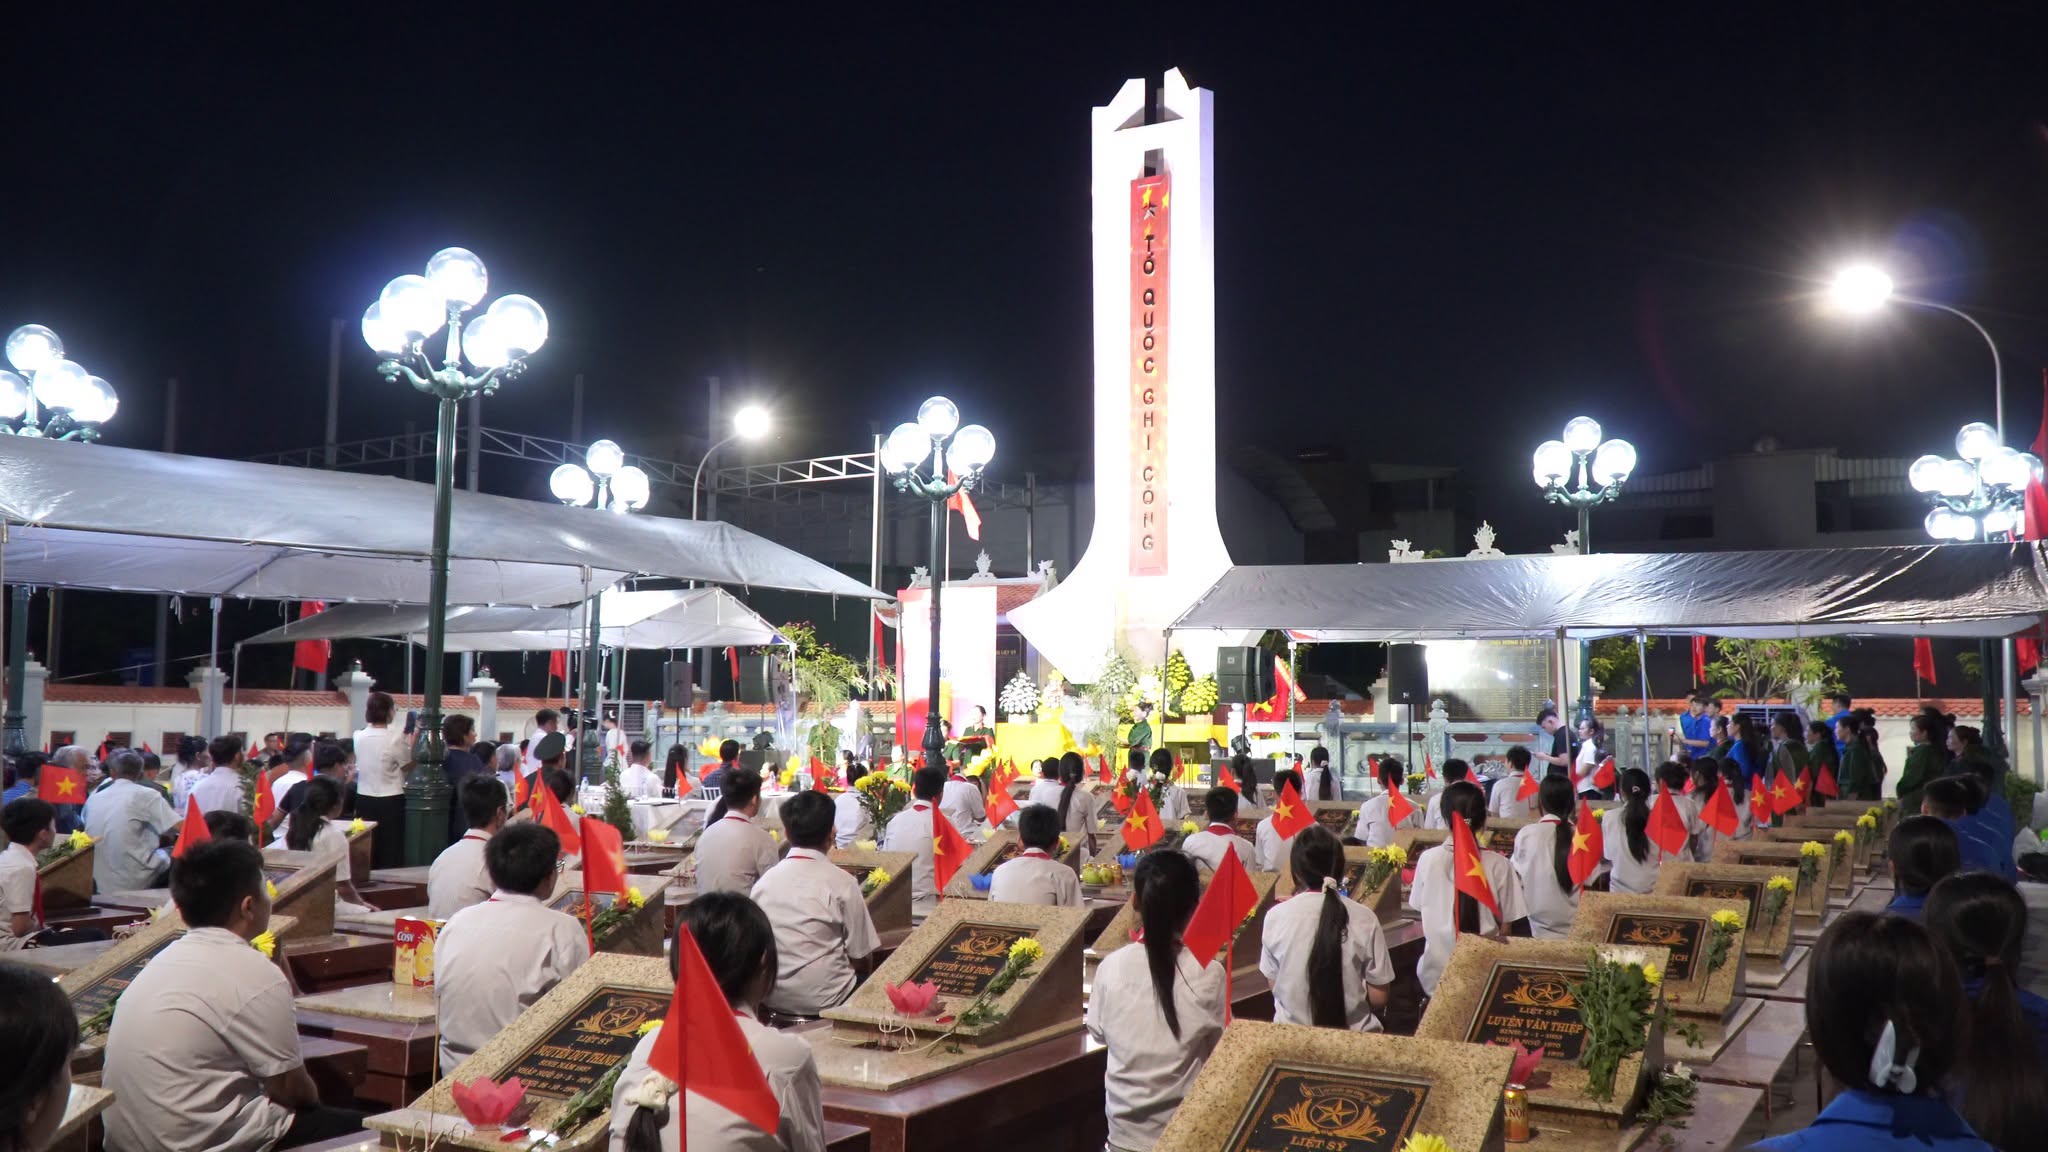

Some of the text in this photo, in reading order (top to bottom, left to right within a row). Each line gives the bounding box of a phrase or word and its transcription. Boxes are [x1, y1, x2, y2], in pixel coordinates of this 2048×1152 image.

[1142, 235, 1155, 550] TỔ QUỐC GHI CÔNG
[1525, 1017, 1548, 1030] VĂN
[1551, 1020, 1584, 1035] THIỆP
[1289, 1135, 1325, 1149] LIỆT
